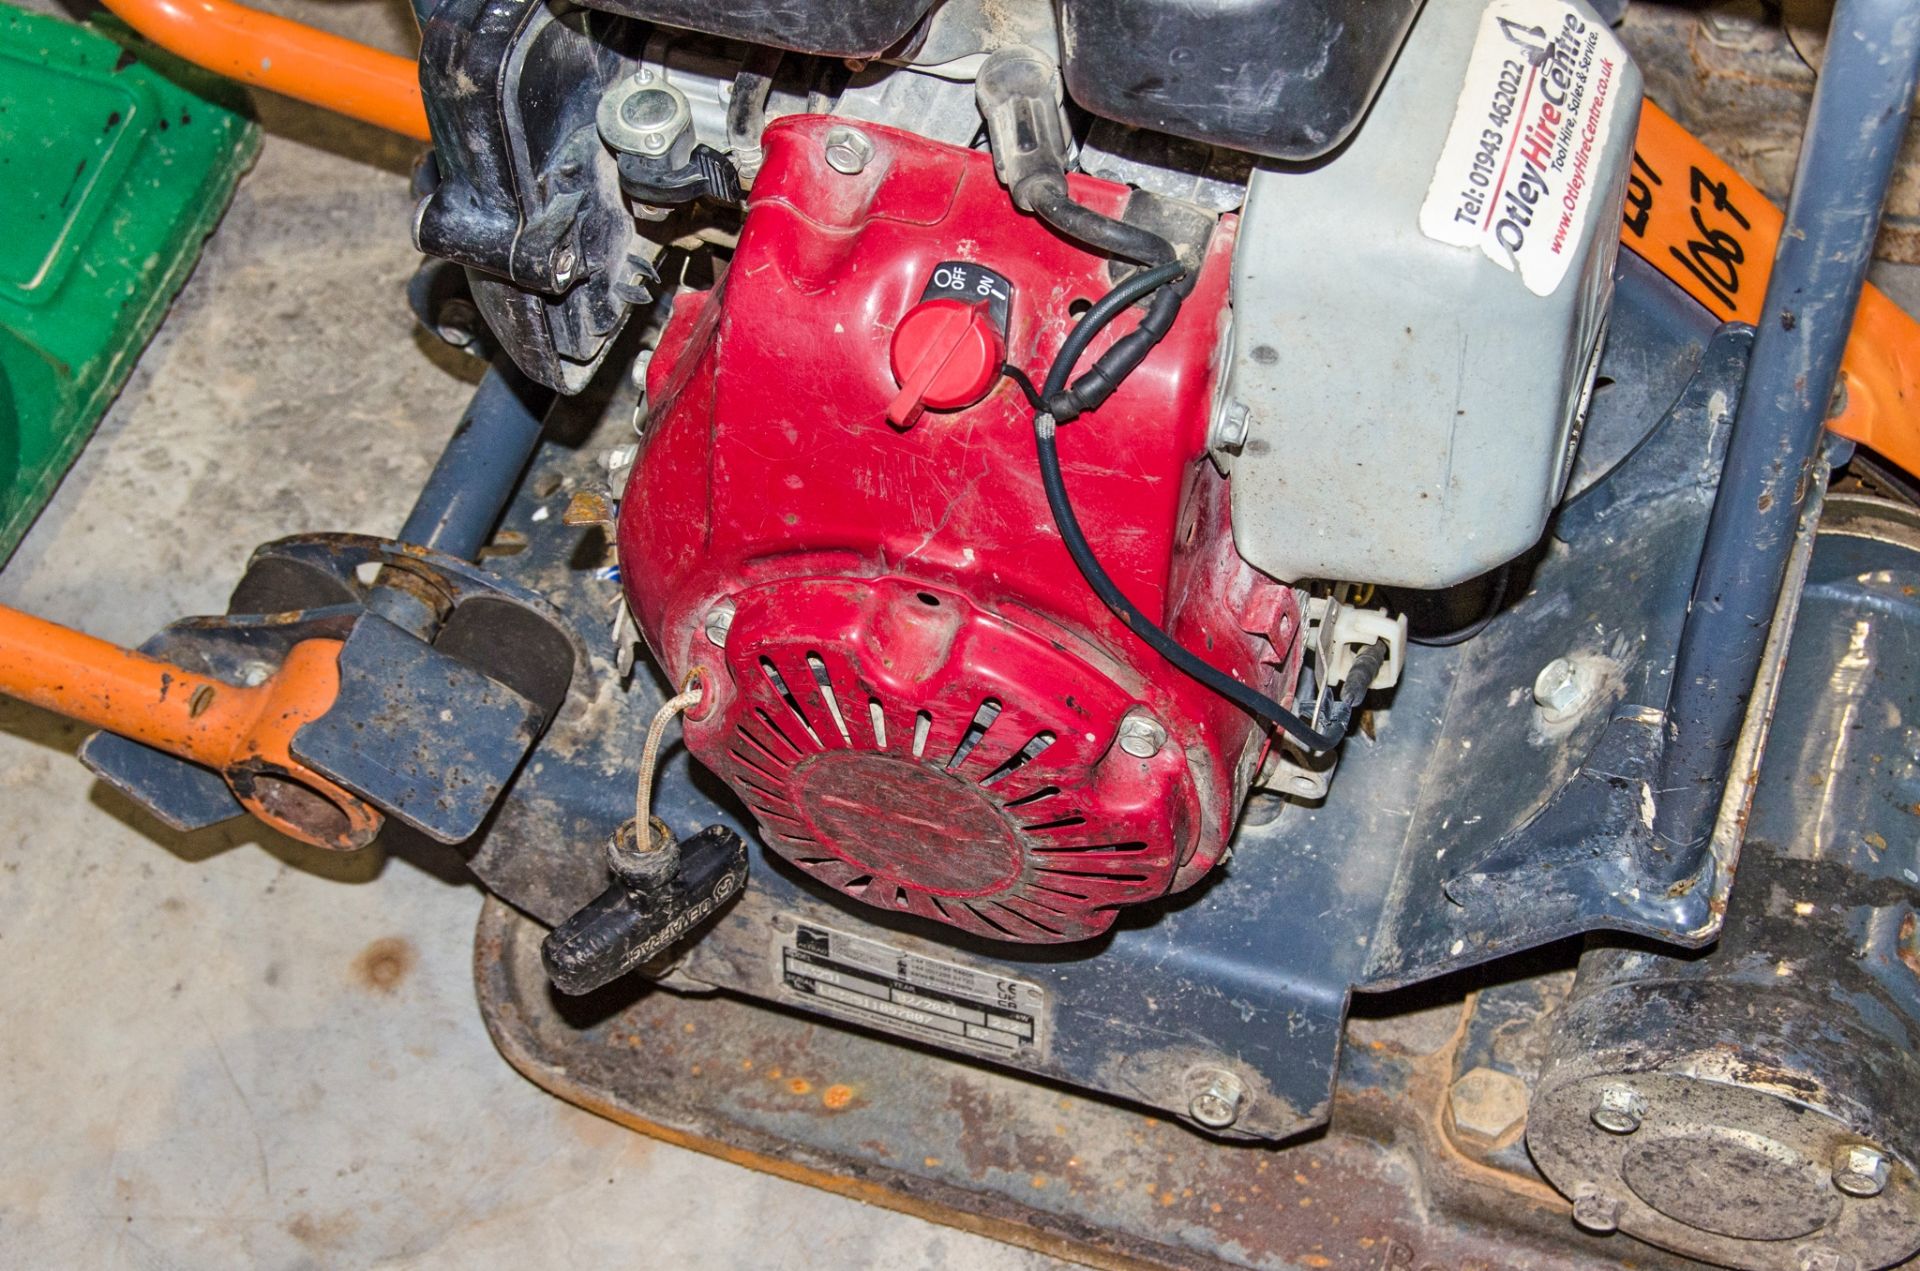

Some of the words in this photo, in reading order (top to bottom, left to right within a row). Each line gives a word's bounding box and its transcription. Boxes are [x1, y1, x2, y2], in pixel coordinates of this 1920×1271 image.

[1578, 32, 1600, 73] Service.
[1488, 59, 1525, 128] 462022
[1575, 72, 1588, 84] &
[1567, 84, 1585, 116] Sales
[1495, 13, 1586, 252] OtleyHireCentre
[1558, 118, 1578, 147] Hire,
[1469, 128, 1503, 187] 01943
[1550, 57, 1614, 255] www.OtleyHireCentre.co.uk
[1551, 144, 1567, 173] Tool
[1454, 188, 1486, 225] Tel:
[1668, 165, 1751, 311] 1067
[951, 267, 967, 290] OFF
[977, 275, 995, 295] ON
